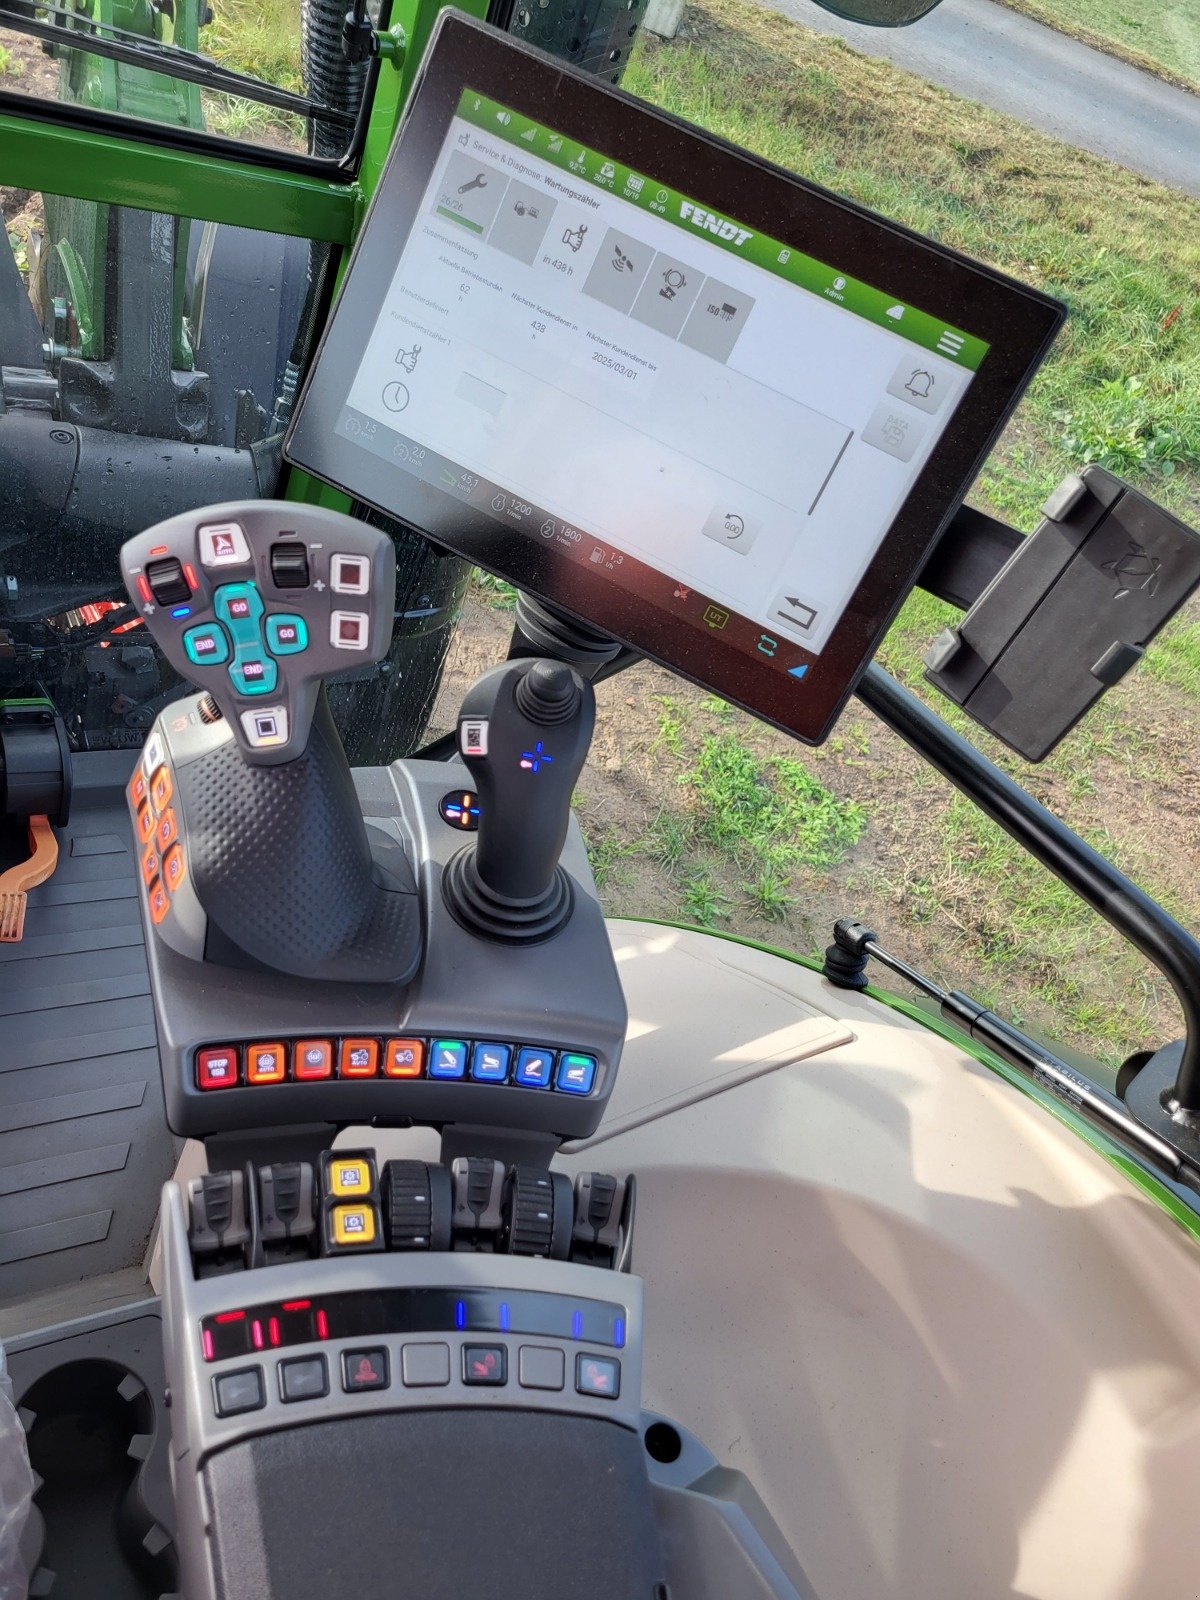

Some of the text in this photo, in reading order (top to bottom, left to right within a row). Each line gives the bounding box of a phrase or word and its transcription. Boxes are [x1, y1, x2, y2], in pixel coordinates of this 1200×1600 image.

[474, 141, 500, 160] Service
[544, 176, 600, 210] Wartungszähler
[440, 194, 464, 212] 26/26
[679, 201, 754, 246] FENDT
[542, 255, 574, 276] in 438 h
[459, 283, 470, 295] 62
[824, 288, 846, 302] Admin
[530, 320, 546, 334] 438
[592, 352, 638, 380] 2025/03/01
[886, 414, 910, 430] DATA
[510, 500, 532, 516] 1200
[560, 526, 582, 543] 1800
[232, 602, 248, 612] GO
[710, 611, 723, 622] UT
[280, 628, 294, 638] GO
[196, 639, 214, 650] END
[244, 664, 263, 675] END
[208, 1058, 228, 1068] STOP
